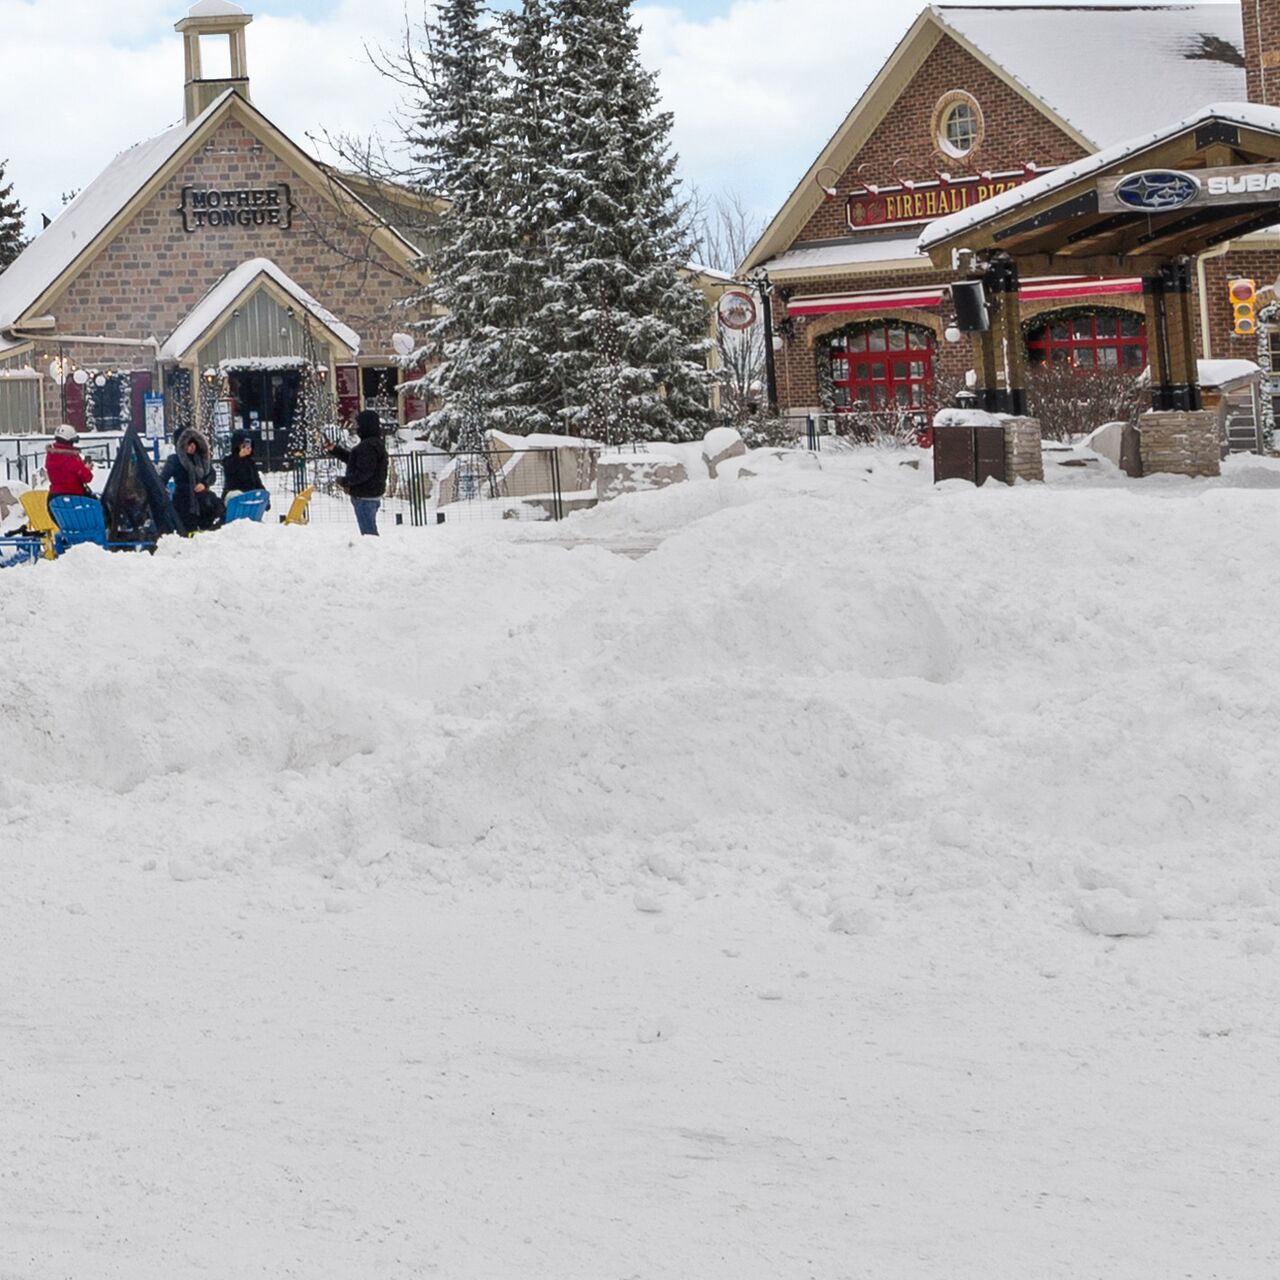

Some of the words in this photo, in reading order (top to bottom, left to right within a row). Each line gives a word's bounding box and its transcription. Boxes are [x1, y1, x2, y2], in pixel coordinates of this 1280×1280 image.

[191, 188, 281, 208] MOTHER
[885, 187, 971, 220] FIREHALL
[192, 208, 281, 227] TONGUE
